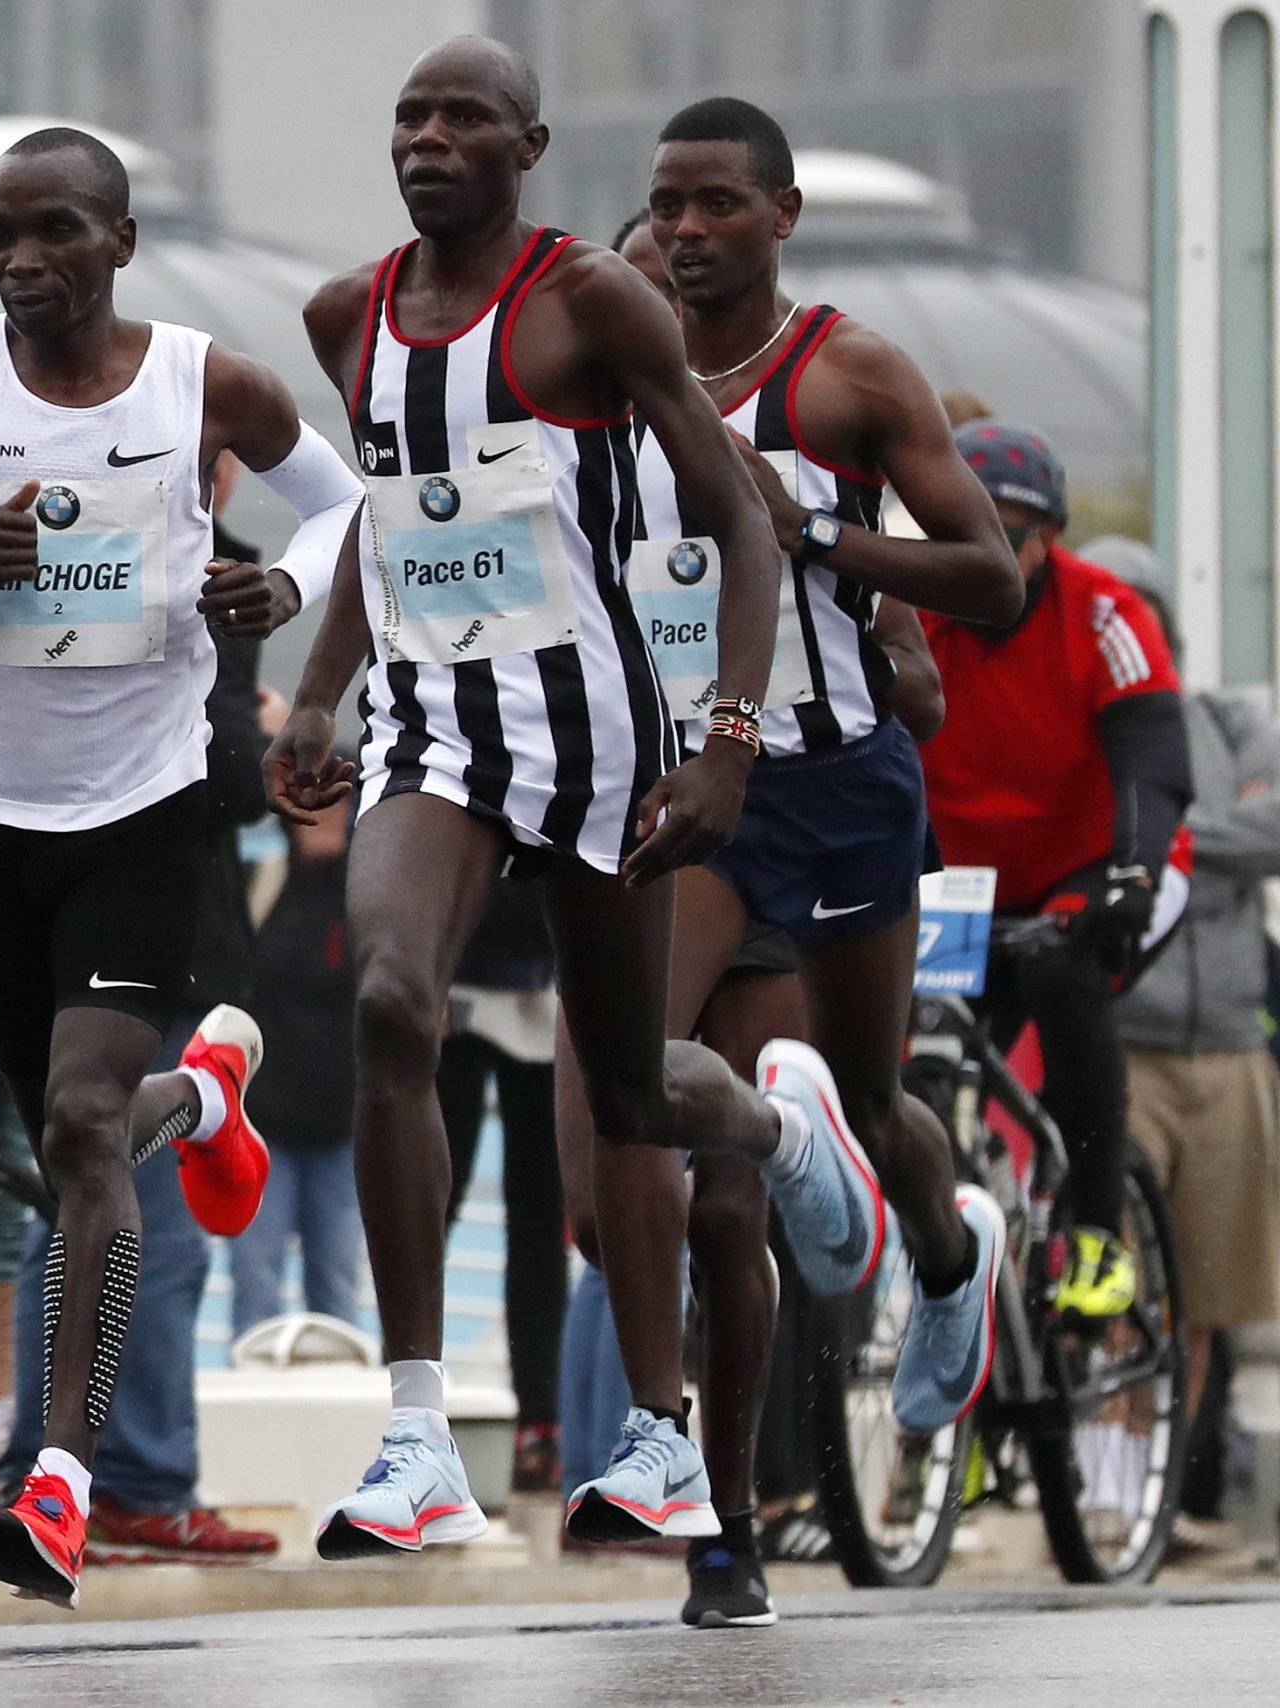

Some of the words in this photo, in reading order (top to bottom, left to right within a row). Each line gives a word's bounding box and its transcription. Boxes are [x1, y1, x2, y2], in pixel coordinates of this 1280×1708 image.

[0, 444, 26, 458] NN
[378, 447, 395, 459] NN
[41, 487, 77, 503] BMW
[403, 559, 465, 587] Pace
[473, 548, 505, 579] 61
[54, 602, 64, 615] 2
[382, 600, 393, 627] BMW
[46, 629, 79, 659] here
[451, 618, 484, 652] here
[652, 619, 707, 645] Pace
